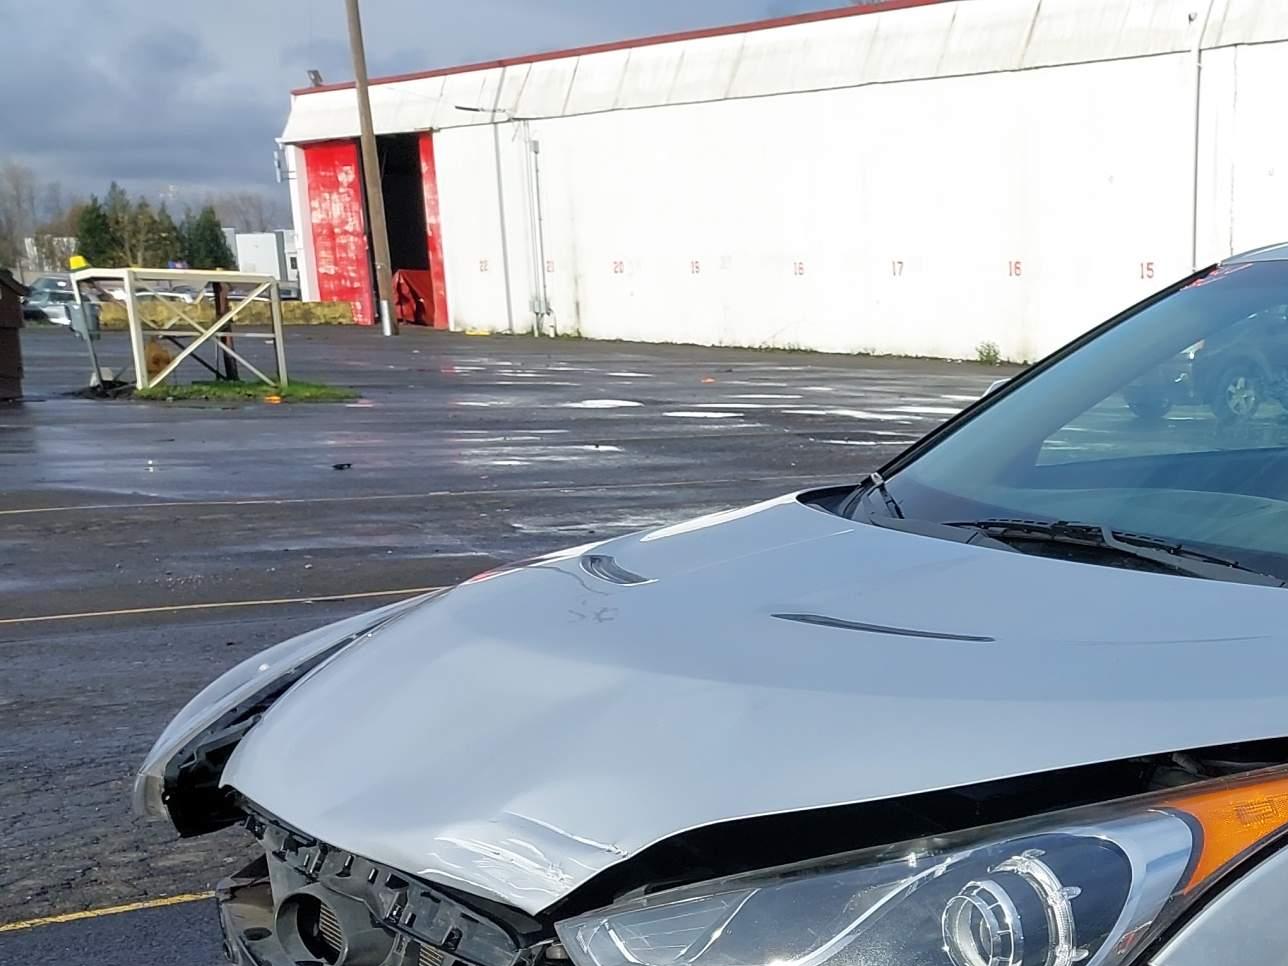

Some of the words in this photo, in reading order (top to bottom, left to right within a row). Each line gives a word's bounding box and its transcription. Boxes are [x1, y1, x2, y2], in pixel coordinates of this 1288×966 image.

[892, 261, 904, 276] 17
[1008, 260, 1022, 276] 16
[1140, 262, 1154, 279] 15
